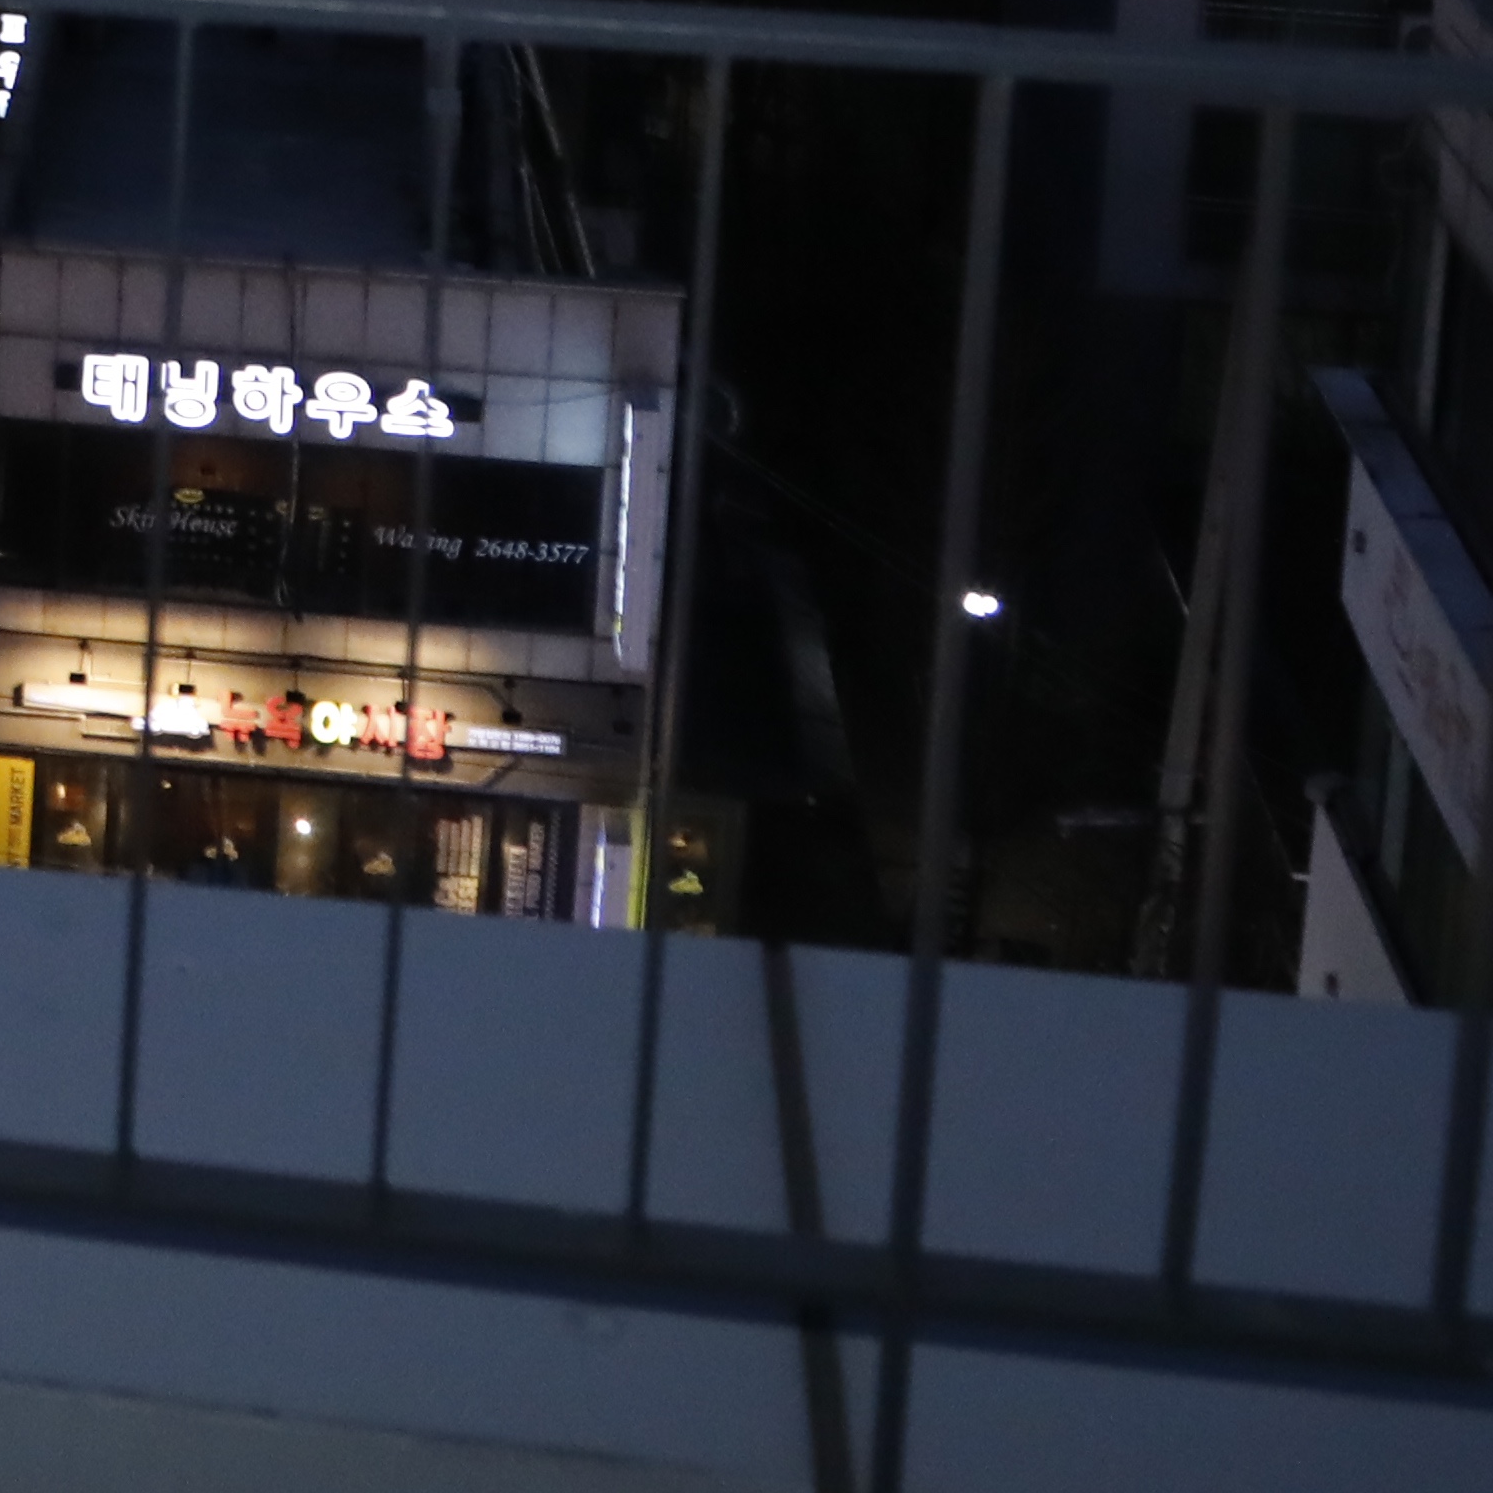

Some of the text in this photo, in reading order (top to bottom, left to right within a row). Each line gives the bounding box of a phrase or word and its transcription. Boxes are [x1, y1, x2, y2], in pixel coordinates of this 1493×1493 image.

[82, 353, 456, 440] 태닝하우스
[373, 524, 591, 568] Waing 2648-3577
[216, 690, 454, 760] 뉴욕야시장
